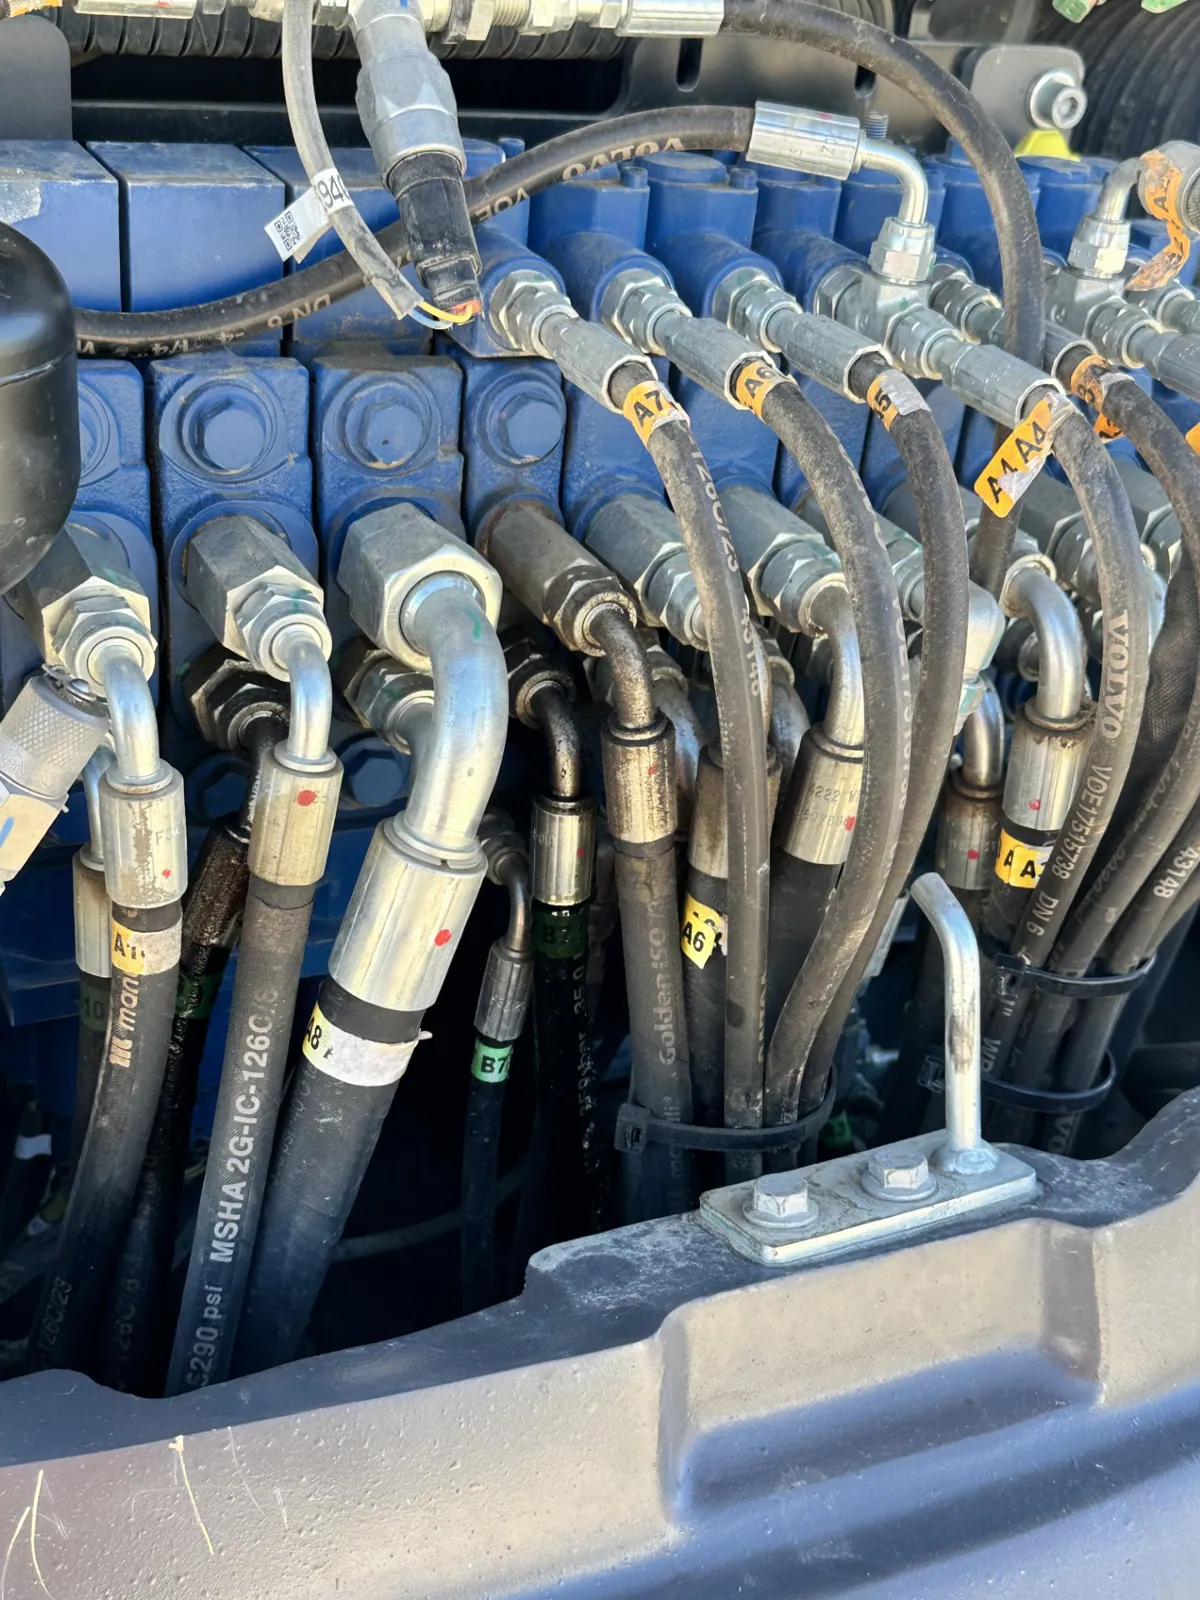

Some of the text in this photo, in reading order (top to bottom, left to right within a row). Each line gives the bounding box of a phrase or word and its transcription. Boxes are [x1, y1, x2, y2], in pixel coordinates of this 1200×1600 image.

[744, 366, 776, 399] A6
[633, 389, 664, 428] A7
[1101, 609, 1130, 739] VOLVO
[1051, 763, 1114, 880] VOE17515738
[1153, 845, 1200, 900] 43148
[1032, 891, 1060, 922] DN
[682, 920, 708, 953] A6
[1025, 921, 1045, 936] 6
[304, 1017, 323, 1050] A8
[209, 1180, 247, 1265] MSHA
[203, 1283, 224, 1321] psi
